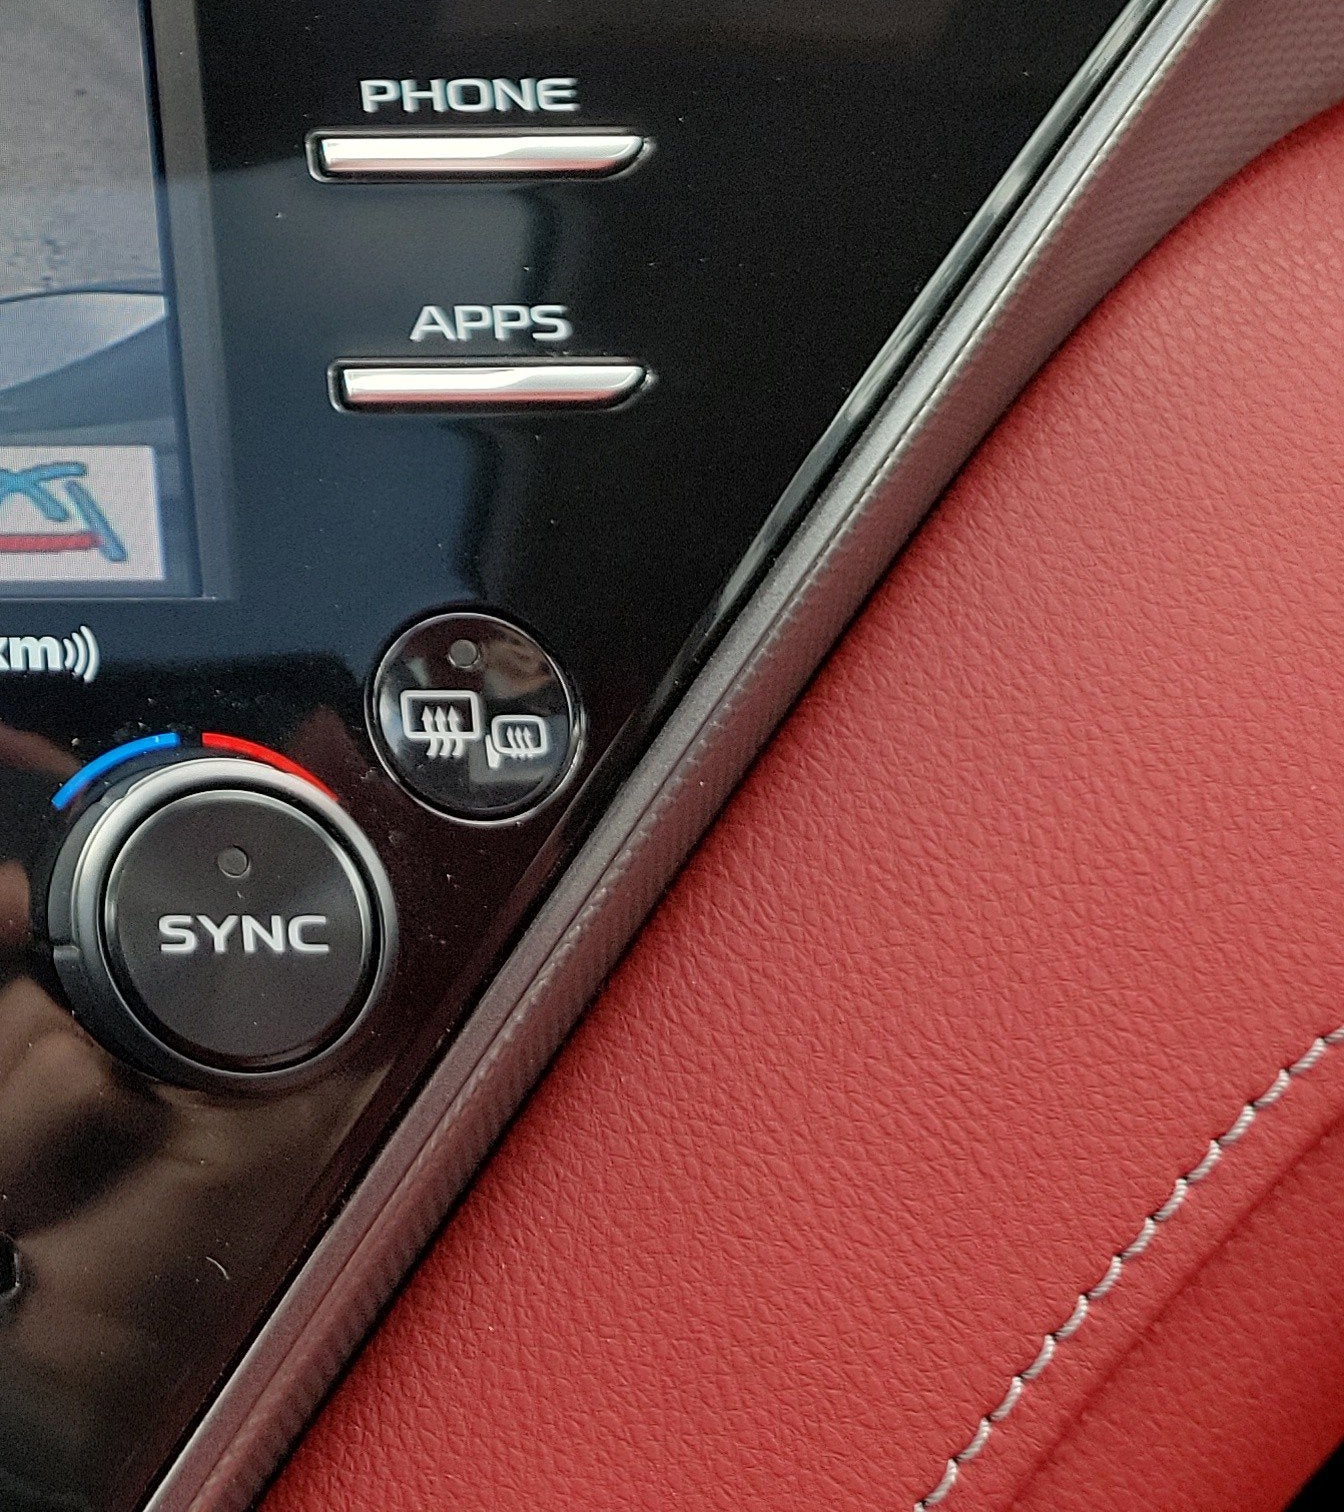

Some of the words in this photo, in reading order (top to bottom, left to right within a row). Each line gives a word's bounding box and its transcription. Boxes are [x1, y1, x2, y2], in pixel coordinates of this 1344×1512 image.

[360, 78, 580, 113] PHONE
[409, 304, 574, 341] APPS
[160, 914, 330, 954] SYNC
